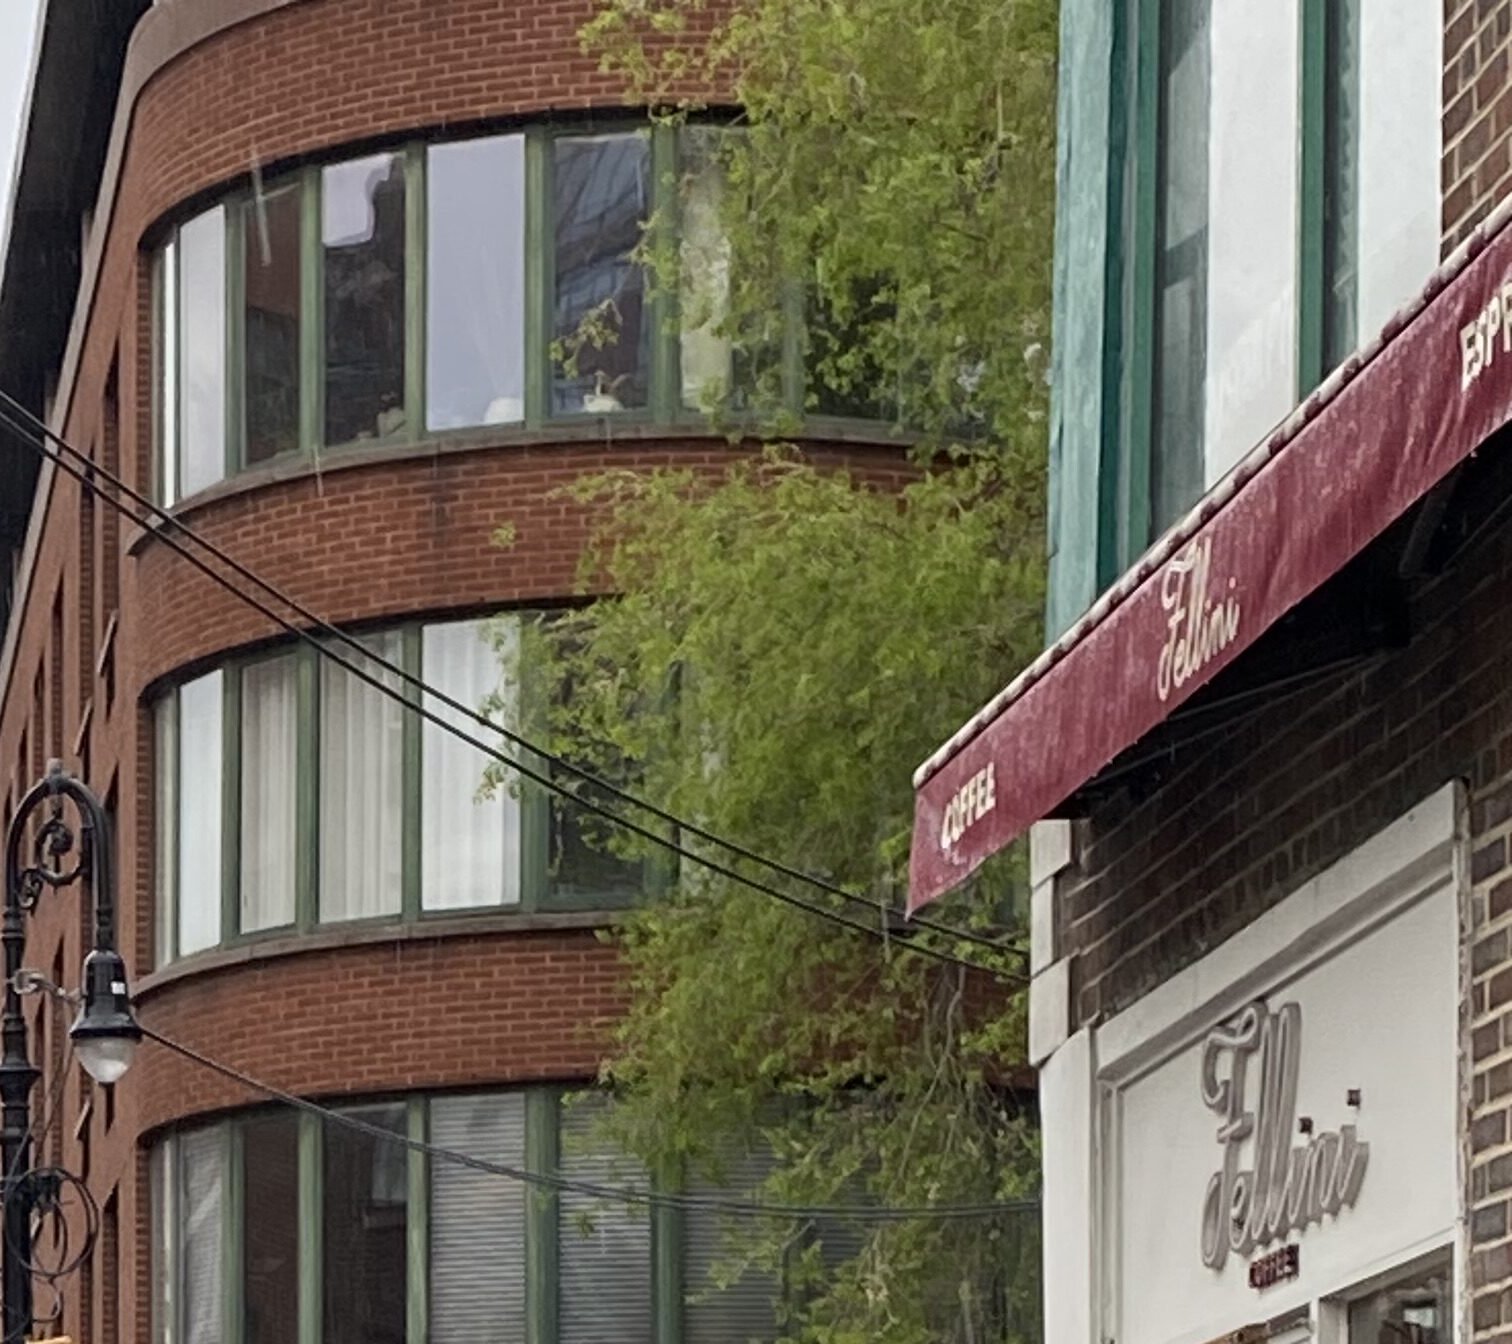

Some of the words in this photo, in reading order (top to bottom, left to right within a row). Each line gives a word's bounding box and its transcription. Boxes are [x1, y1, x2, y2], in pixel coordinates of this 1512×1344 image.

[1158, 535, 1240, 701] Fellini
[941, 761, 996, 850] COFFEE
[1201, 1000, 1370, 1272] Fellini
